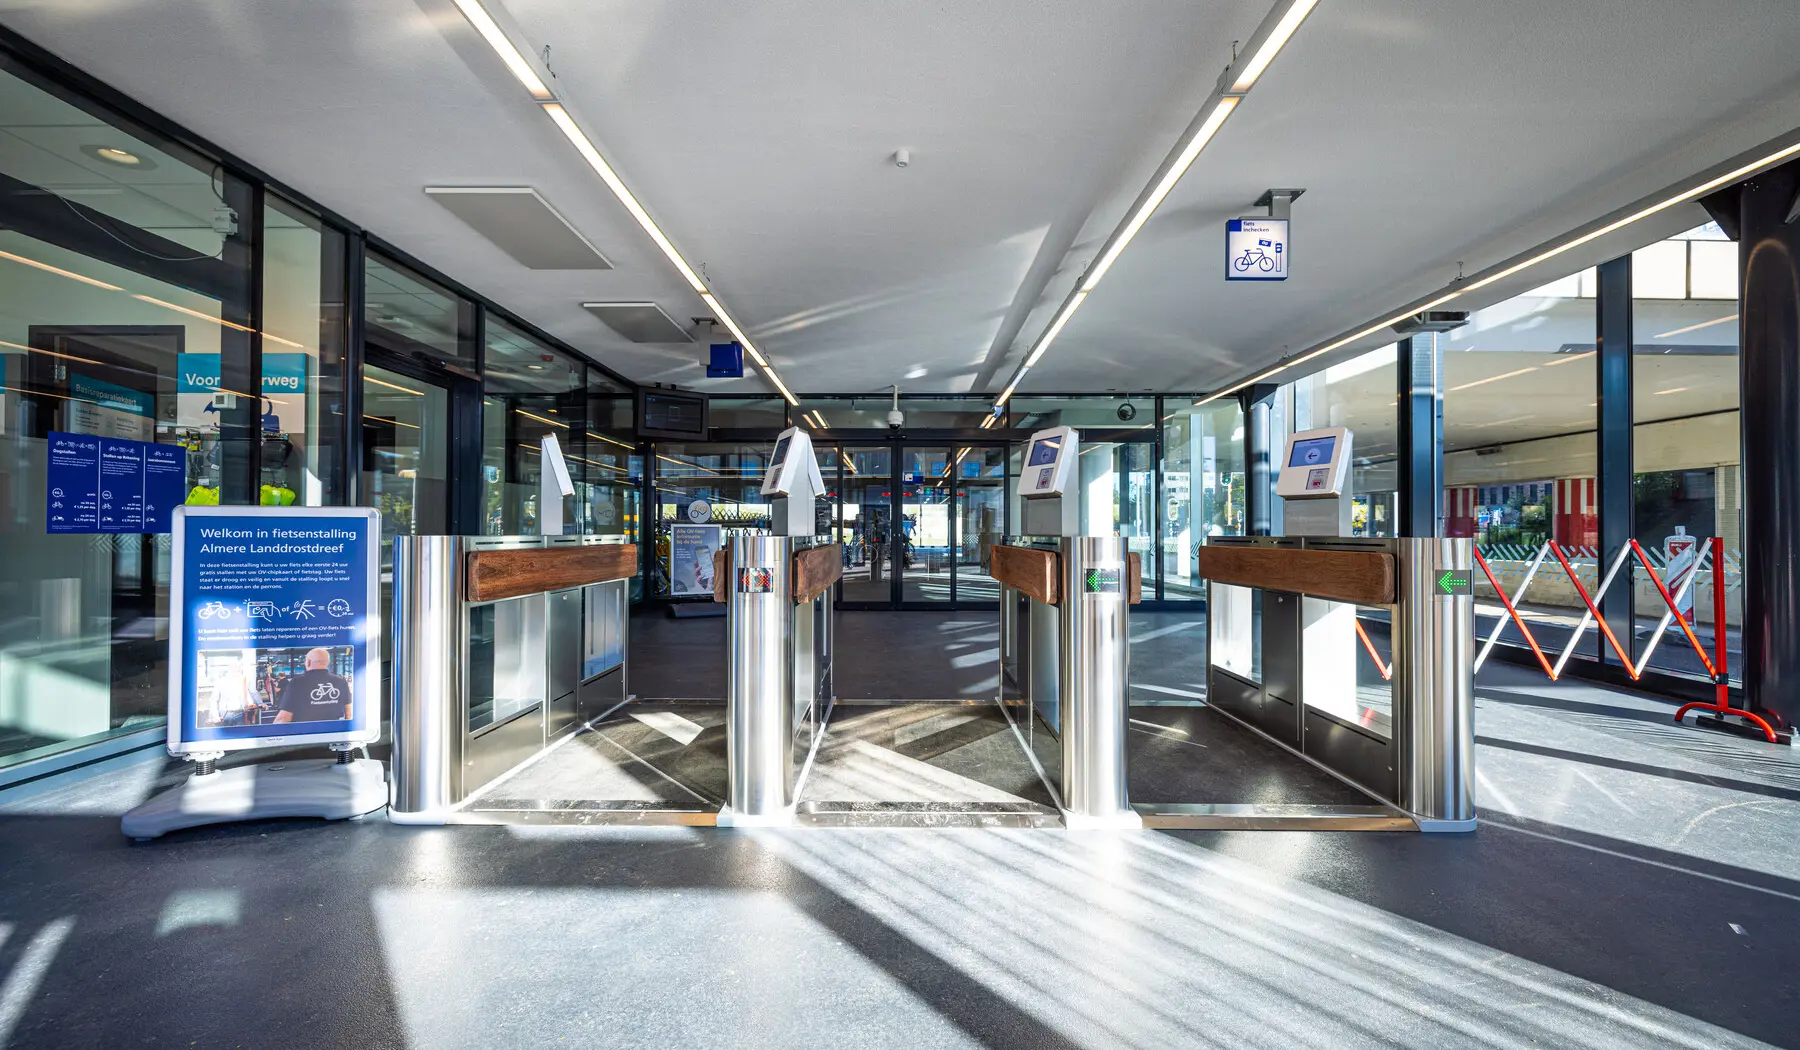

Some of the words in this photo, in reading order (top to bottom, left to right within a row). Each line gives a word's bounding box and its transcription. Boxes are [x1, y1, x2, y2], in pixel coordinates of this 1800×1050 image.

[186, 373, 220, 386] Voor
[200, 528, 252, 538] Welkom
[257, 528, 268, 538] in
[272, 528, 356, 540] fietsenstalling
[200, 544, 246, 553] Almere
[250, 544, 344, 553] Landdrostdreef
